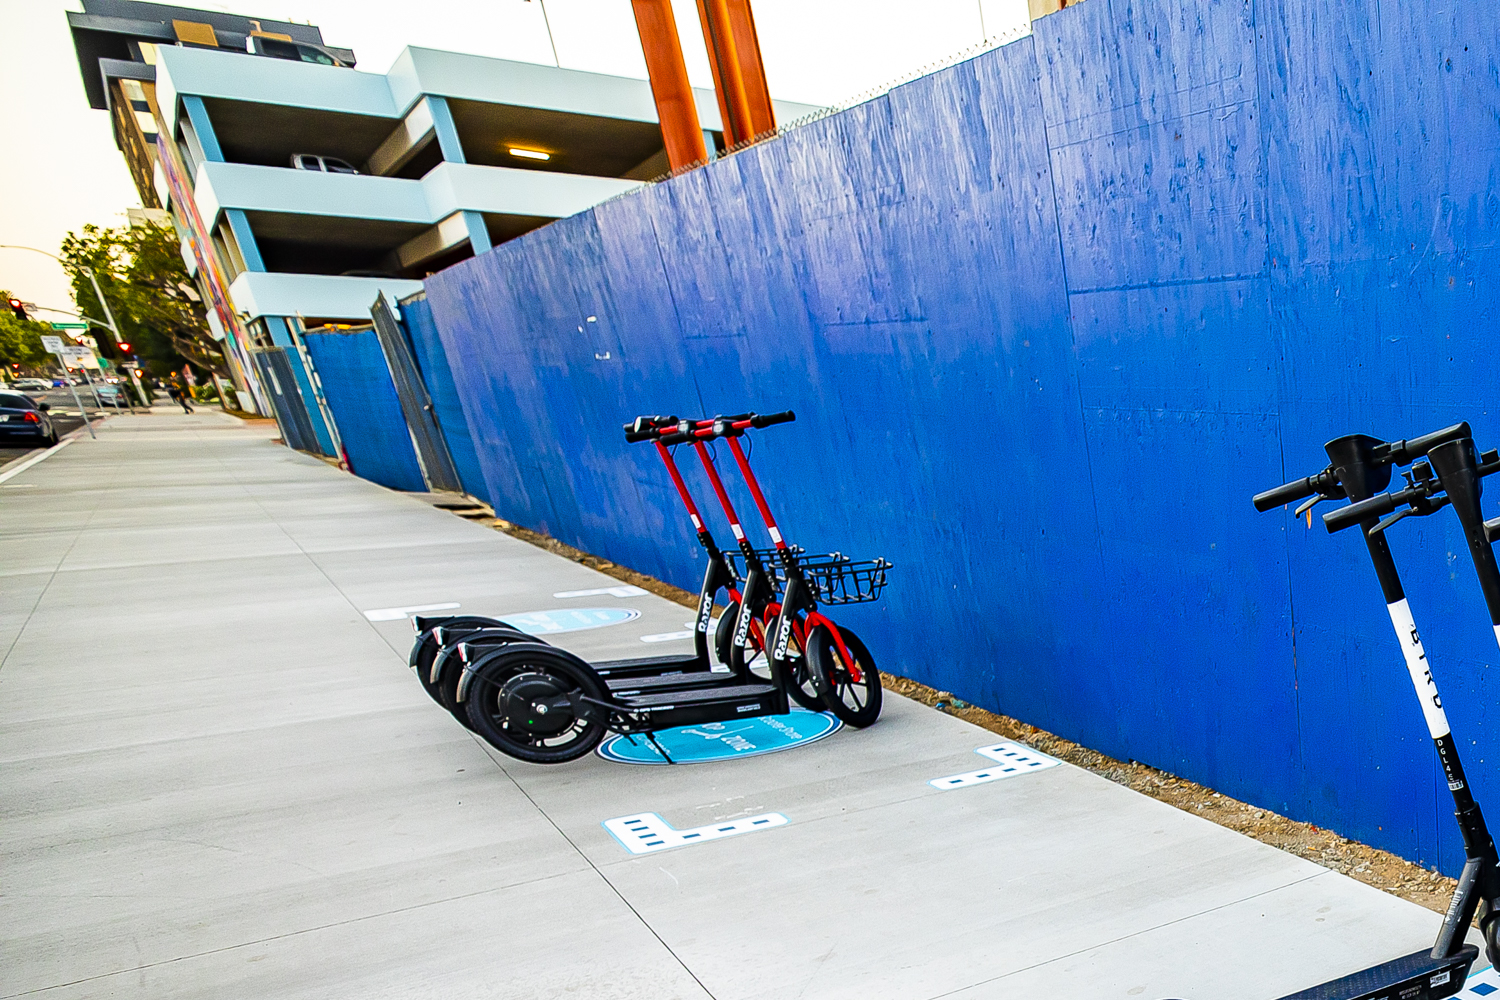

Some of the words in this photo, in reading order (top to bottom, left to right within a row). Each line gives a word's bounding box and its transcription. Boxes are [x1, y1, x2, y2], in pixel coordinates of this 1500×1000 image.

[698, 592, 713, 633] Razor
[735, 603, 752, 647] Razor
[774, 615, 792, 661] Razor
